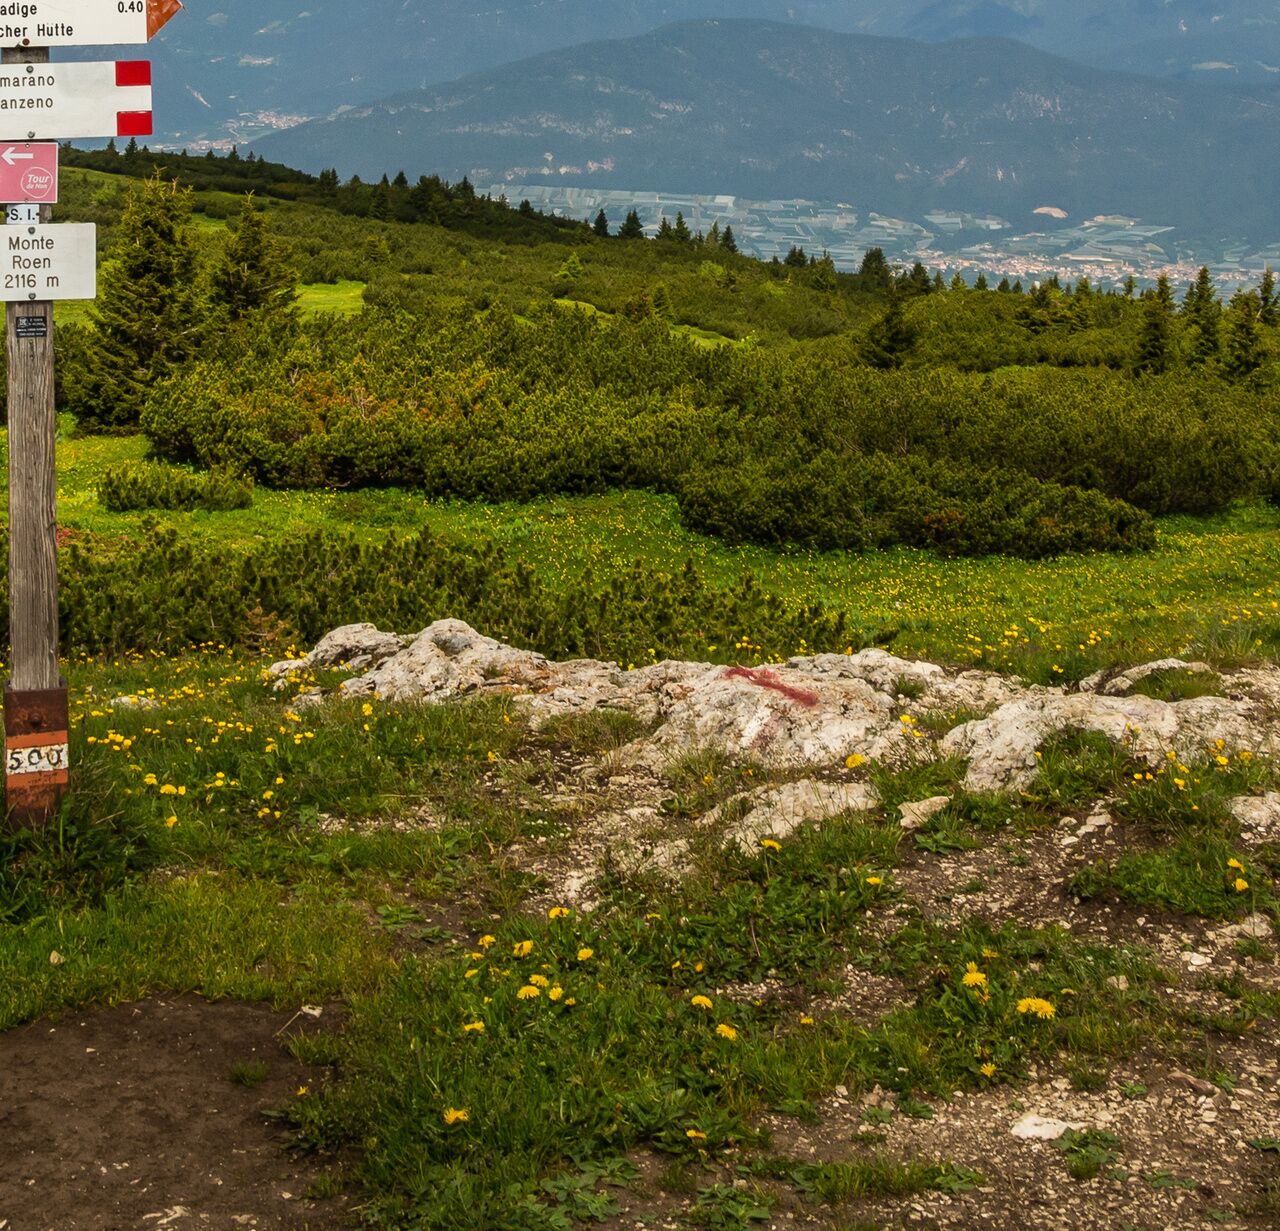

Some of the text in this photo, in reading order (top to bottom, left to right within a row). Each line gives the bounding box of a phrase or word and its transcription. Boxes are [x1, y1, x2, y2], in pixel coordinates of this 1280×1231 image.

[117, 0, 143, 13] 0.40
[27, 174, 50, 184] Tour
[8, 235, 54, 250] Monte
[12, 255, 50, 269] Roen
[4, 273, 58, 288] 2116 m
[8, 749, 64, 771] 500
